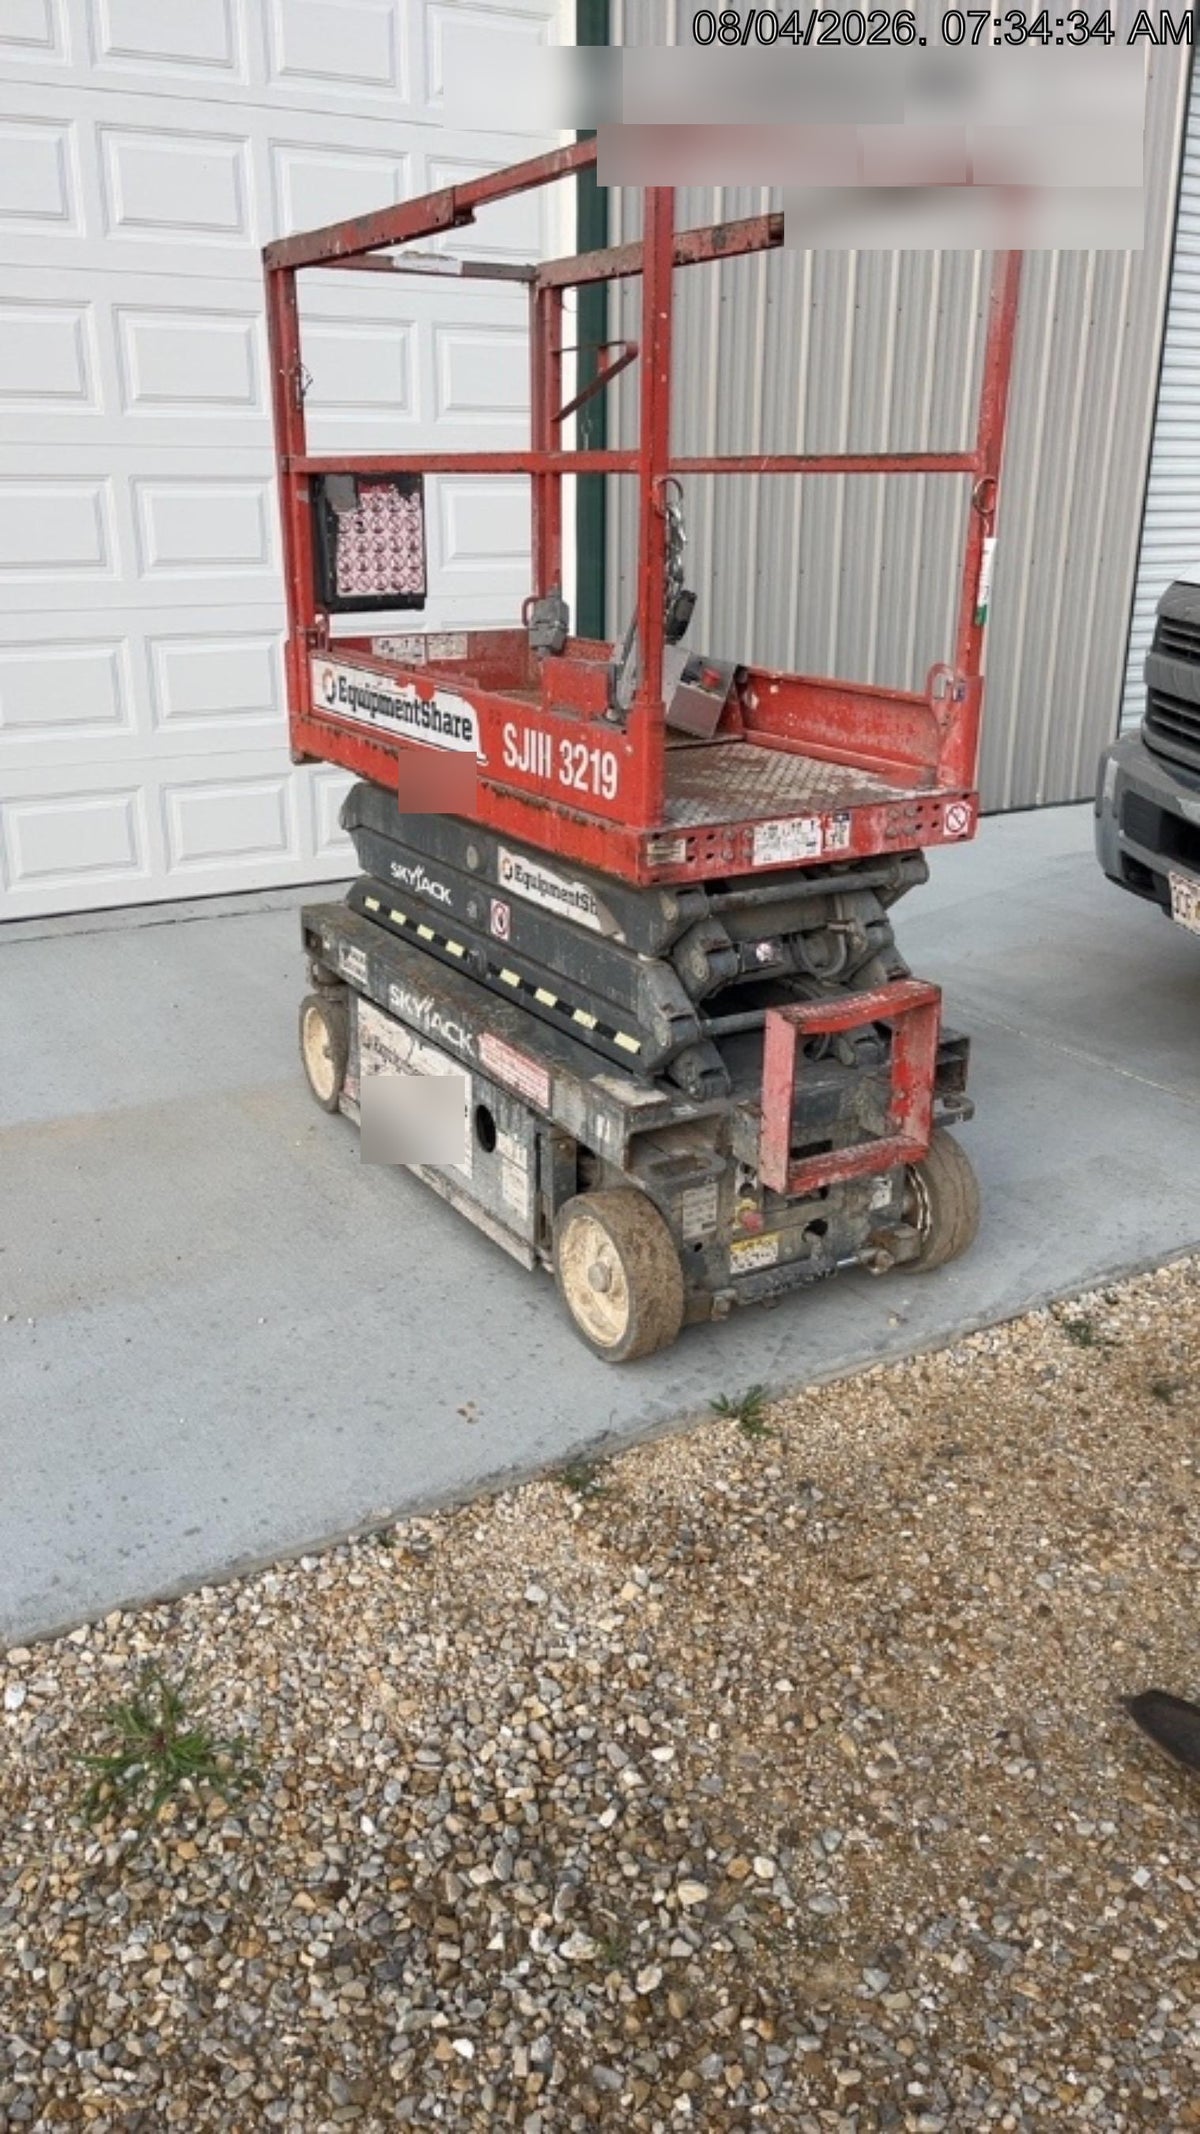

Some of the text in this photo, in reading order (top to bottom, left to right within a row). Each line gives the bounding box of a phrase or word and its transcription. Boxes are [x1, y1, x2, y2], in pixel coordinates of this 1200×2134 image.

[338, 675, 473, 741] EquipmentShare
[559, 739, 618, 800] 3219
[390, 862, 453, 907] SKYJACK
[389, 983, 475, 1058] SKYJACK
